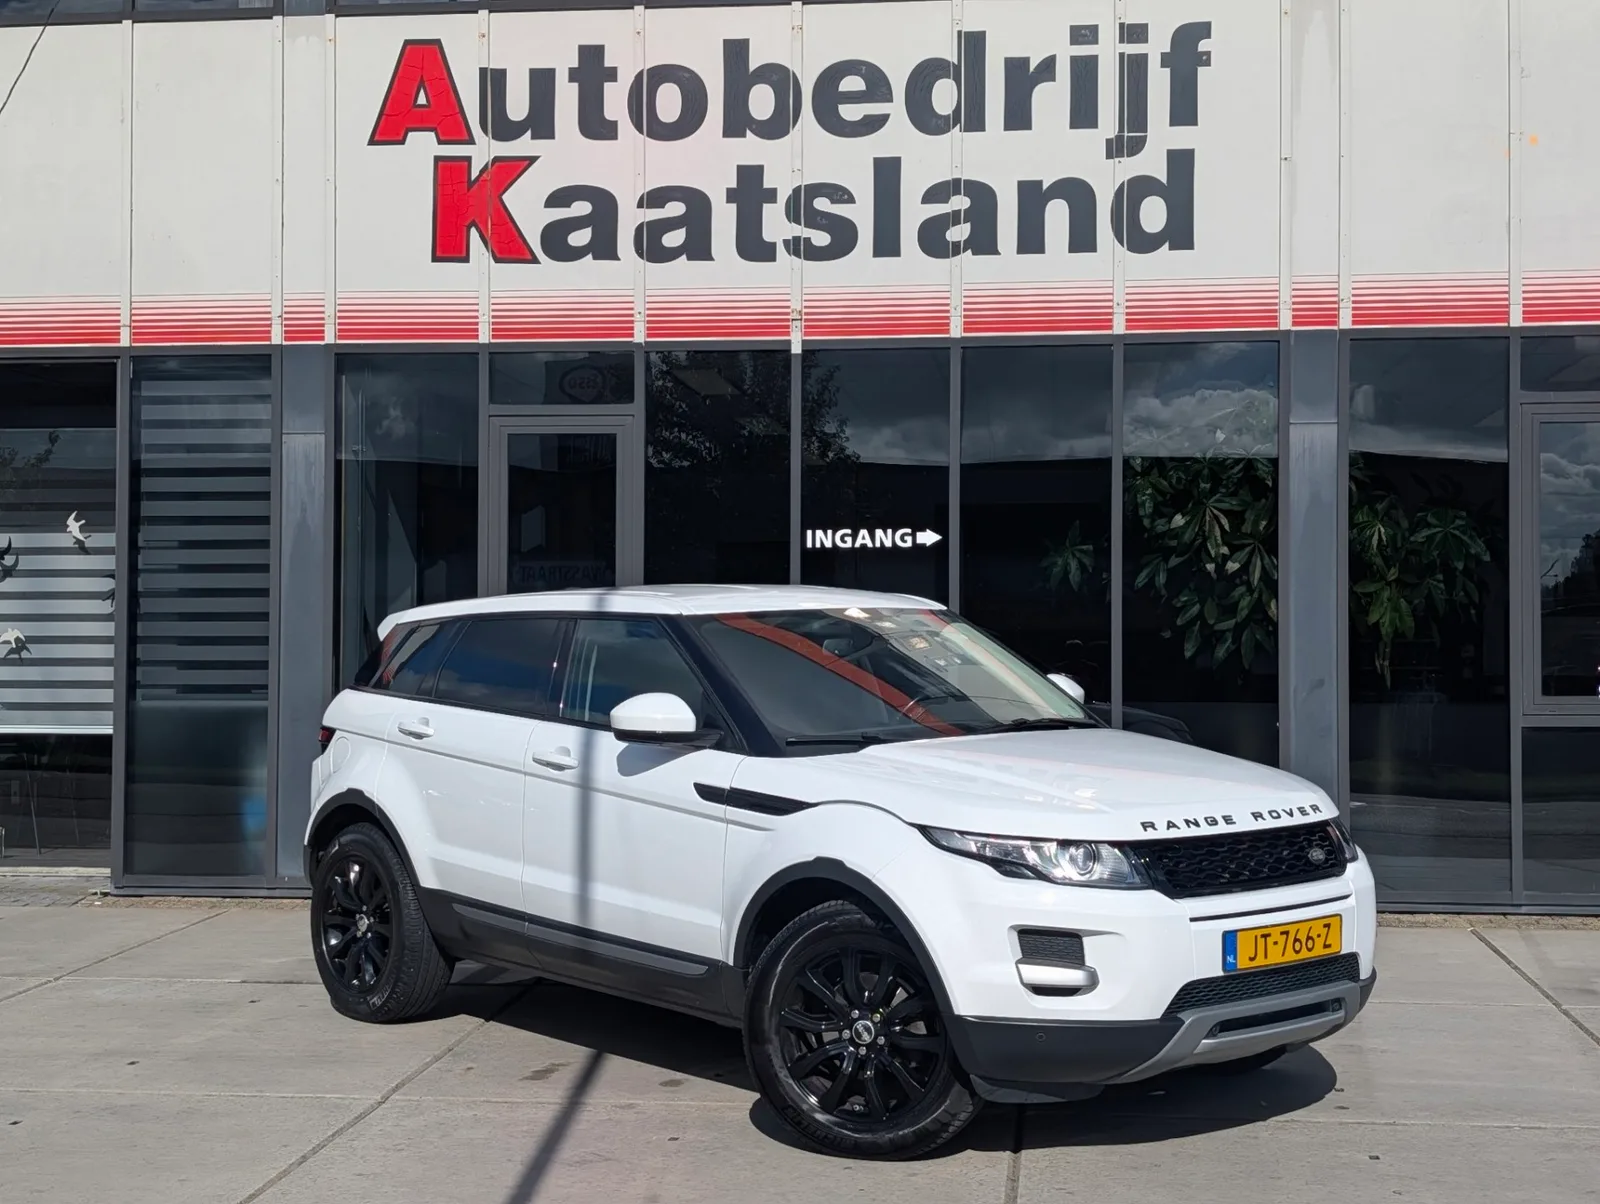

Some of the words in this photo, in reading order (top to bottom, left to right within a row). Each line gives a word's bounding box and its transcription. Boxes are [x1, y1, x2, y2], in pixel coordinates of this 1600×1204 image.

[367, 21, 1212, 160] Autobedrijf
[431, 148, 1196, 265] Kaatsland
[806, 528, 913, 548] INGANG
[1140, 814, 1236, 832] RANGE
[1250, 803, 1322, 822] ROVER
[1227, 954, 1236, 963] NL
[1248, 923, 1332, 962] JT-766-Z
